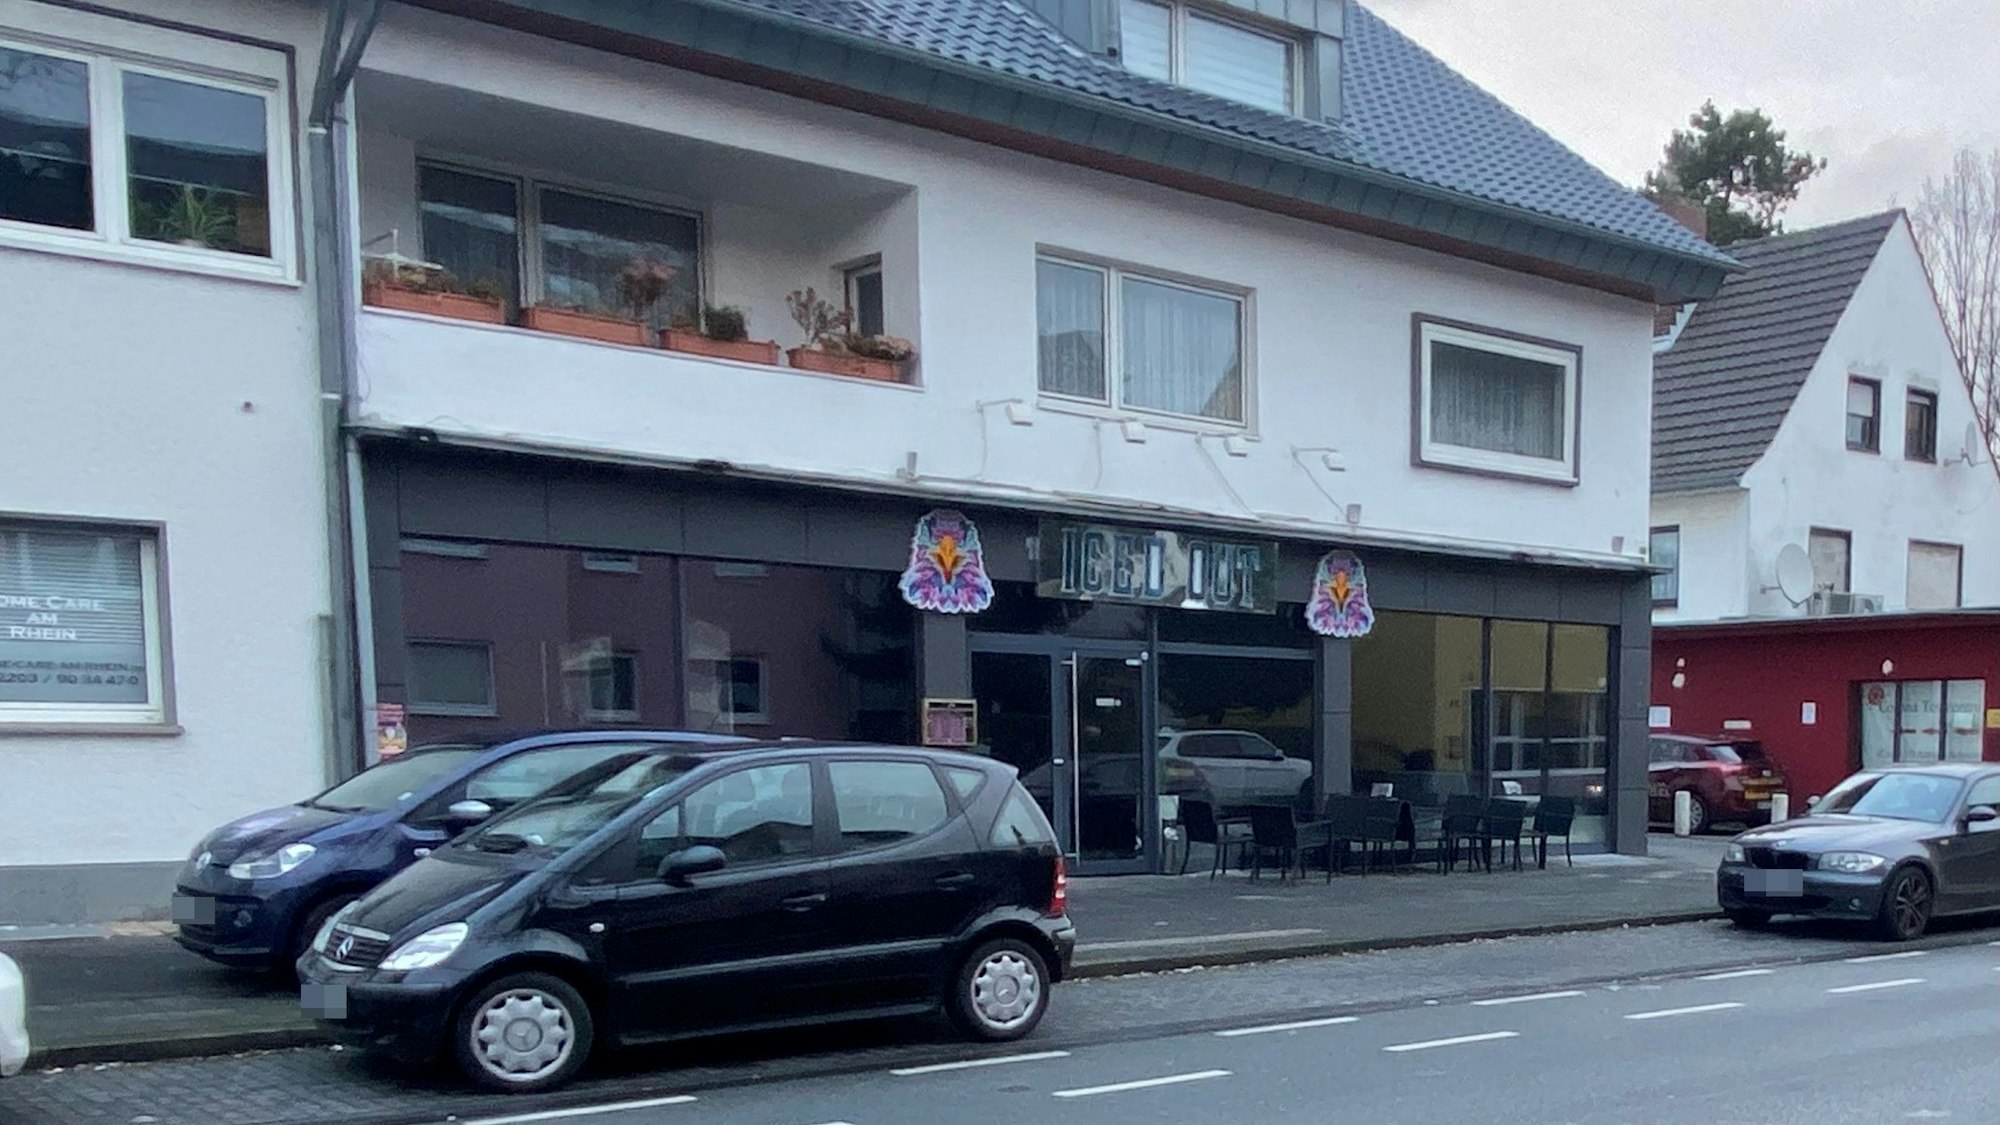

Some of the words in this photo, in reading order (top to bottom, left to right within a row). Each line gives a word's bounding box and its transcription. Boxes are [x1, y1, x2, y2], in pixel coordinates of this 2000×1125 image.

[1061, 528, 1166, 598] ICED
[1187, 540, 1261, 608] OUT
[46, 596, 106, 611] CARE
[26, 612, 58, 625] AM
[10, 626, 77, 640] RHEIN
